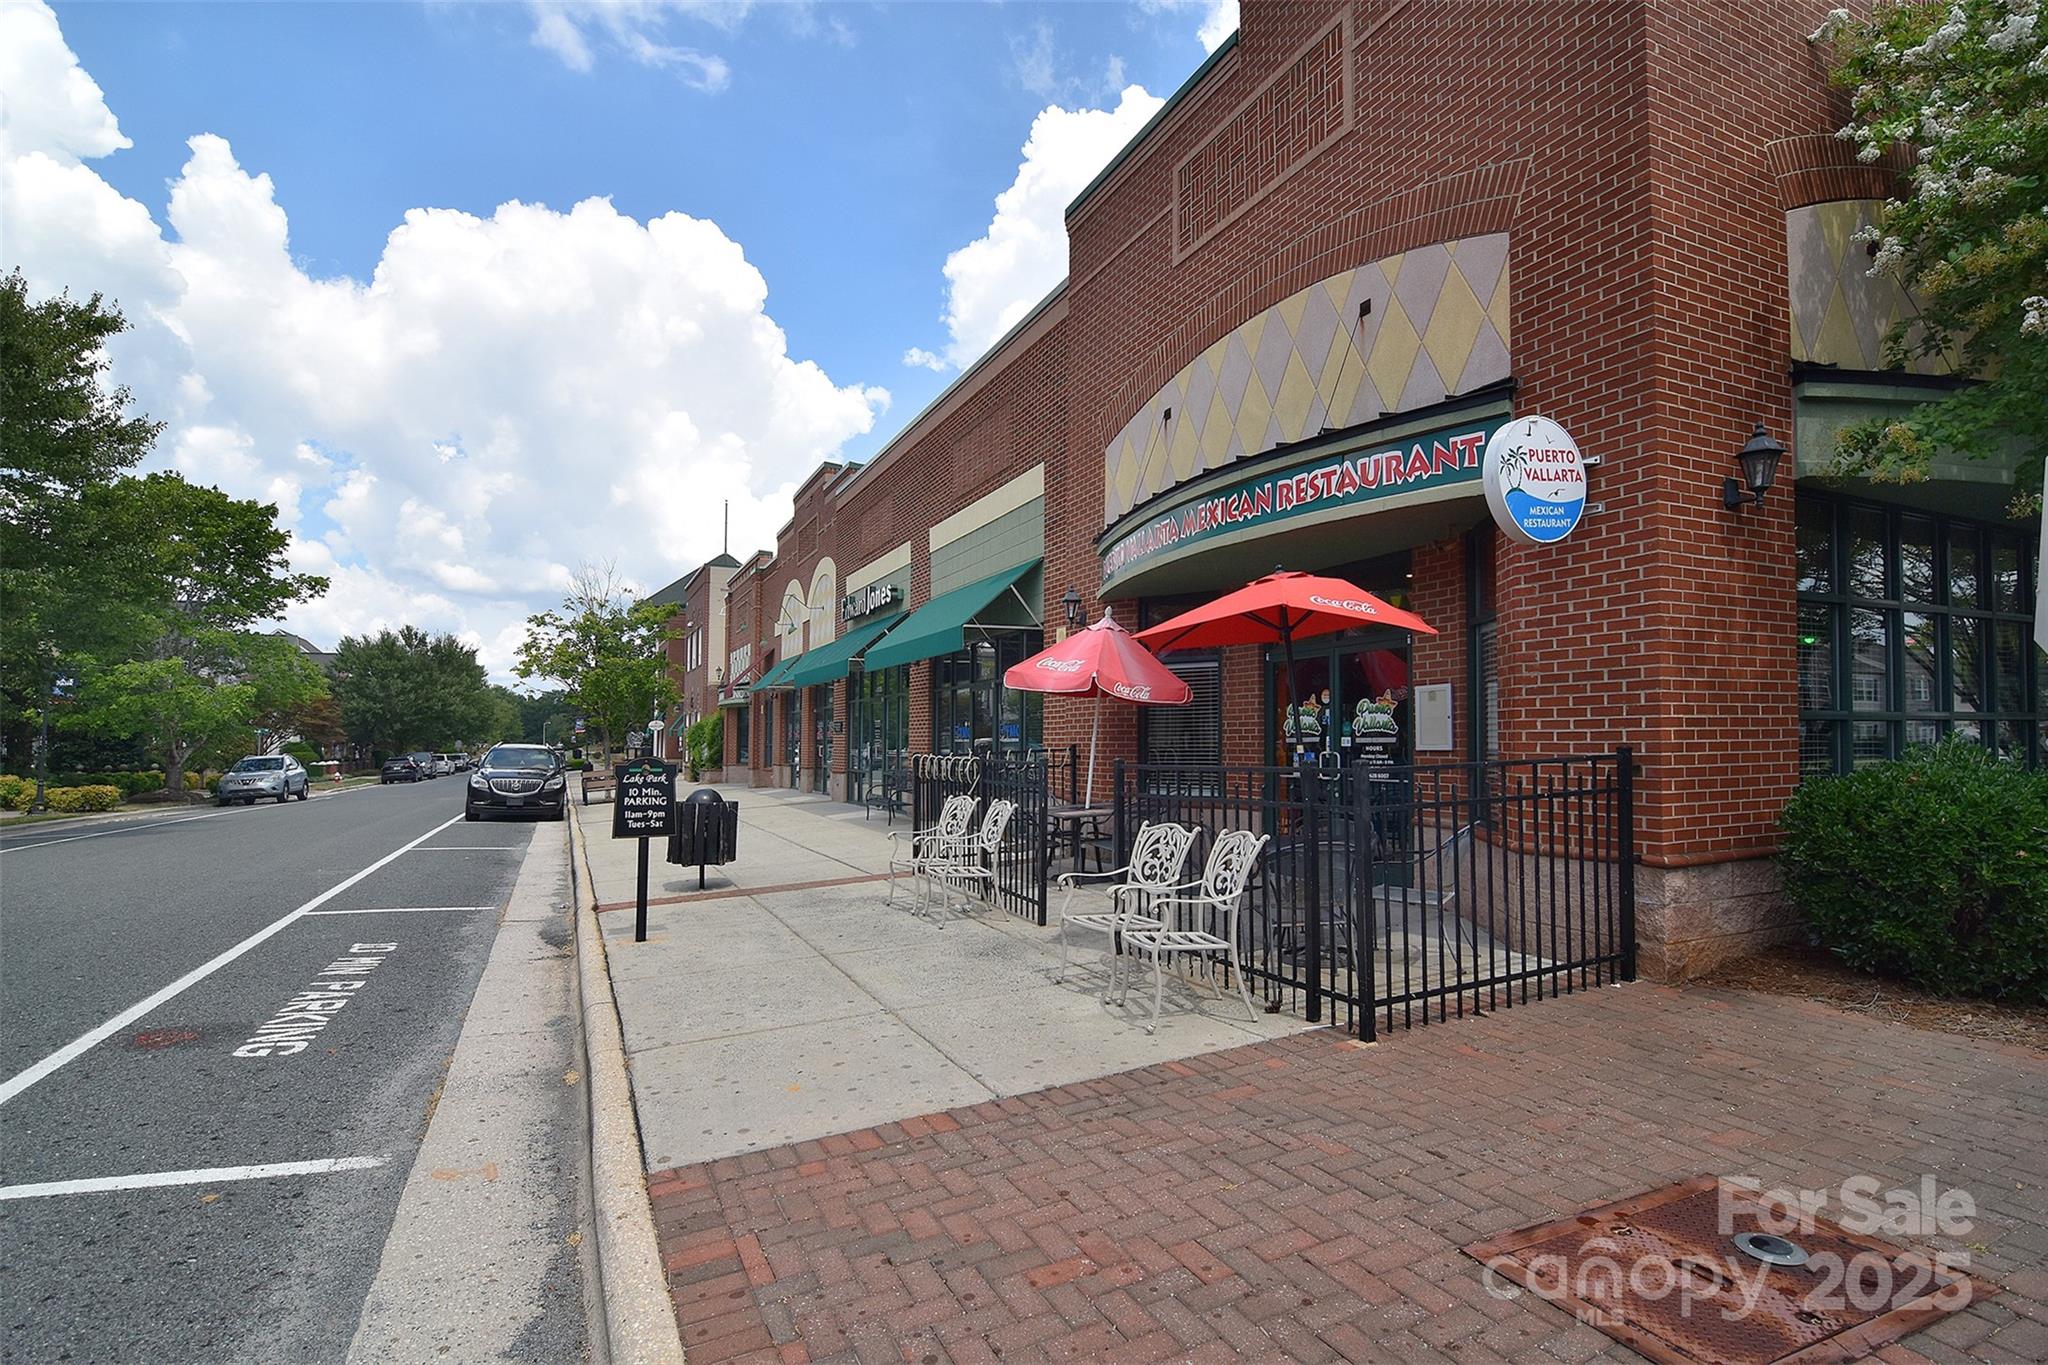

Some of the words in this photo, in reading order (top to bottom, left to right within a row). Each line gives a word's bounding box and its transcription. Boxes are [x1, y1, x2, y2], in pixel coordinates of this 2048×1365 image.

[1528, 448, 1576, 464] PUERTO
[1524, 468, 1583, 482] VALLARTA
[1180, 482, 1272, 538] MEXICAN
[1276, 431, 1486, 512] RESTAURANT
[1529, 506, 1565, 515] MEXICAN
[1523, 518, 1571, 528] RESTAURANT
[865, 584, 892, 615] Jones
[623, 773, 645, 785] Lake
[645, 773, 669, 785] Park
[628, 788, 639, 796] 10
[641, 787, 663, 796] Min.
[624, 796, 667, 806] PARKING
[624, 810, 666, 819] 11am-9pm
[627, 819, 663, 828] Tues-Sat
[232, 980, 367, 1058] PARKING
